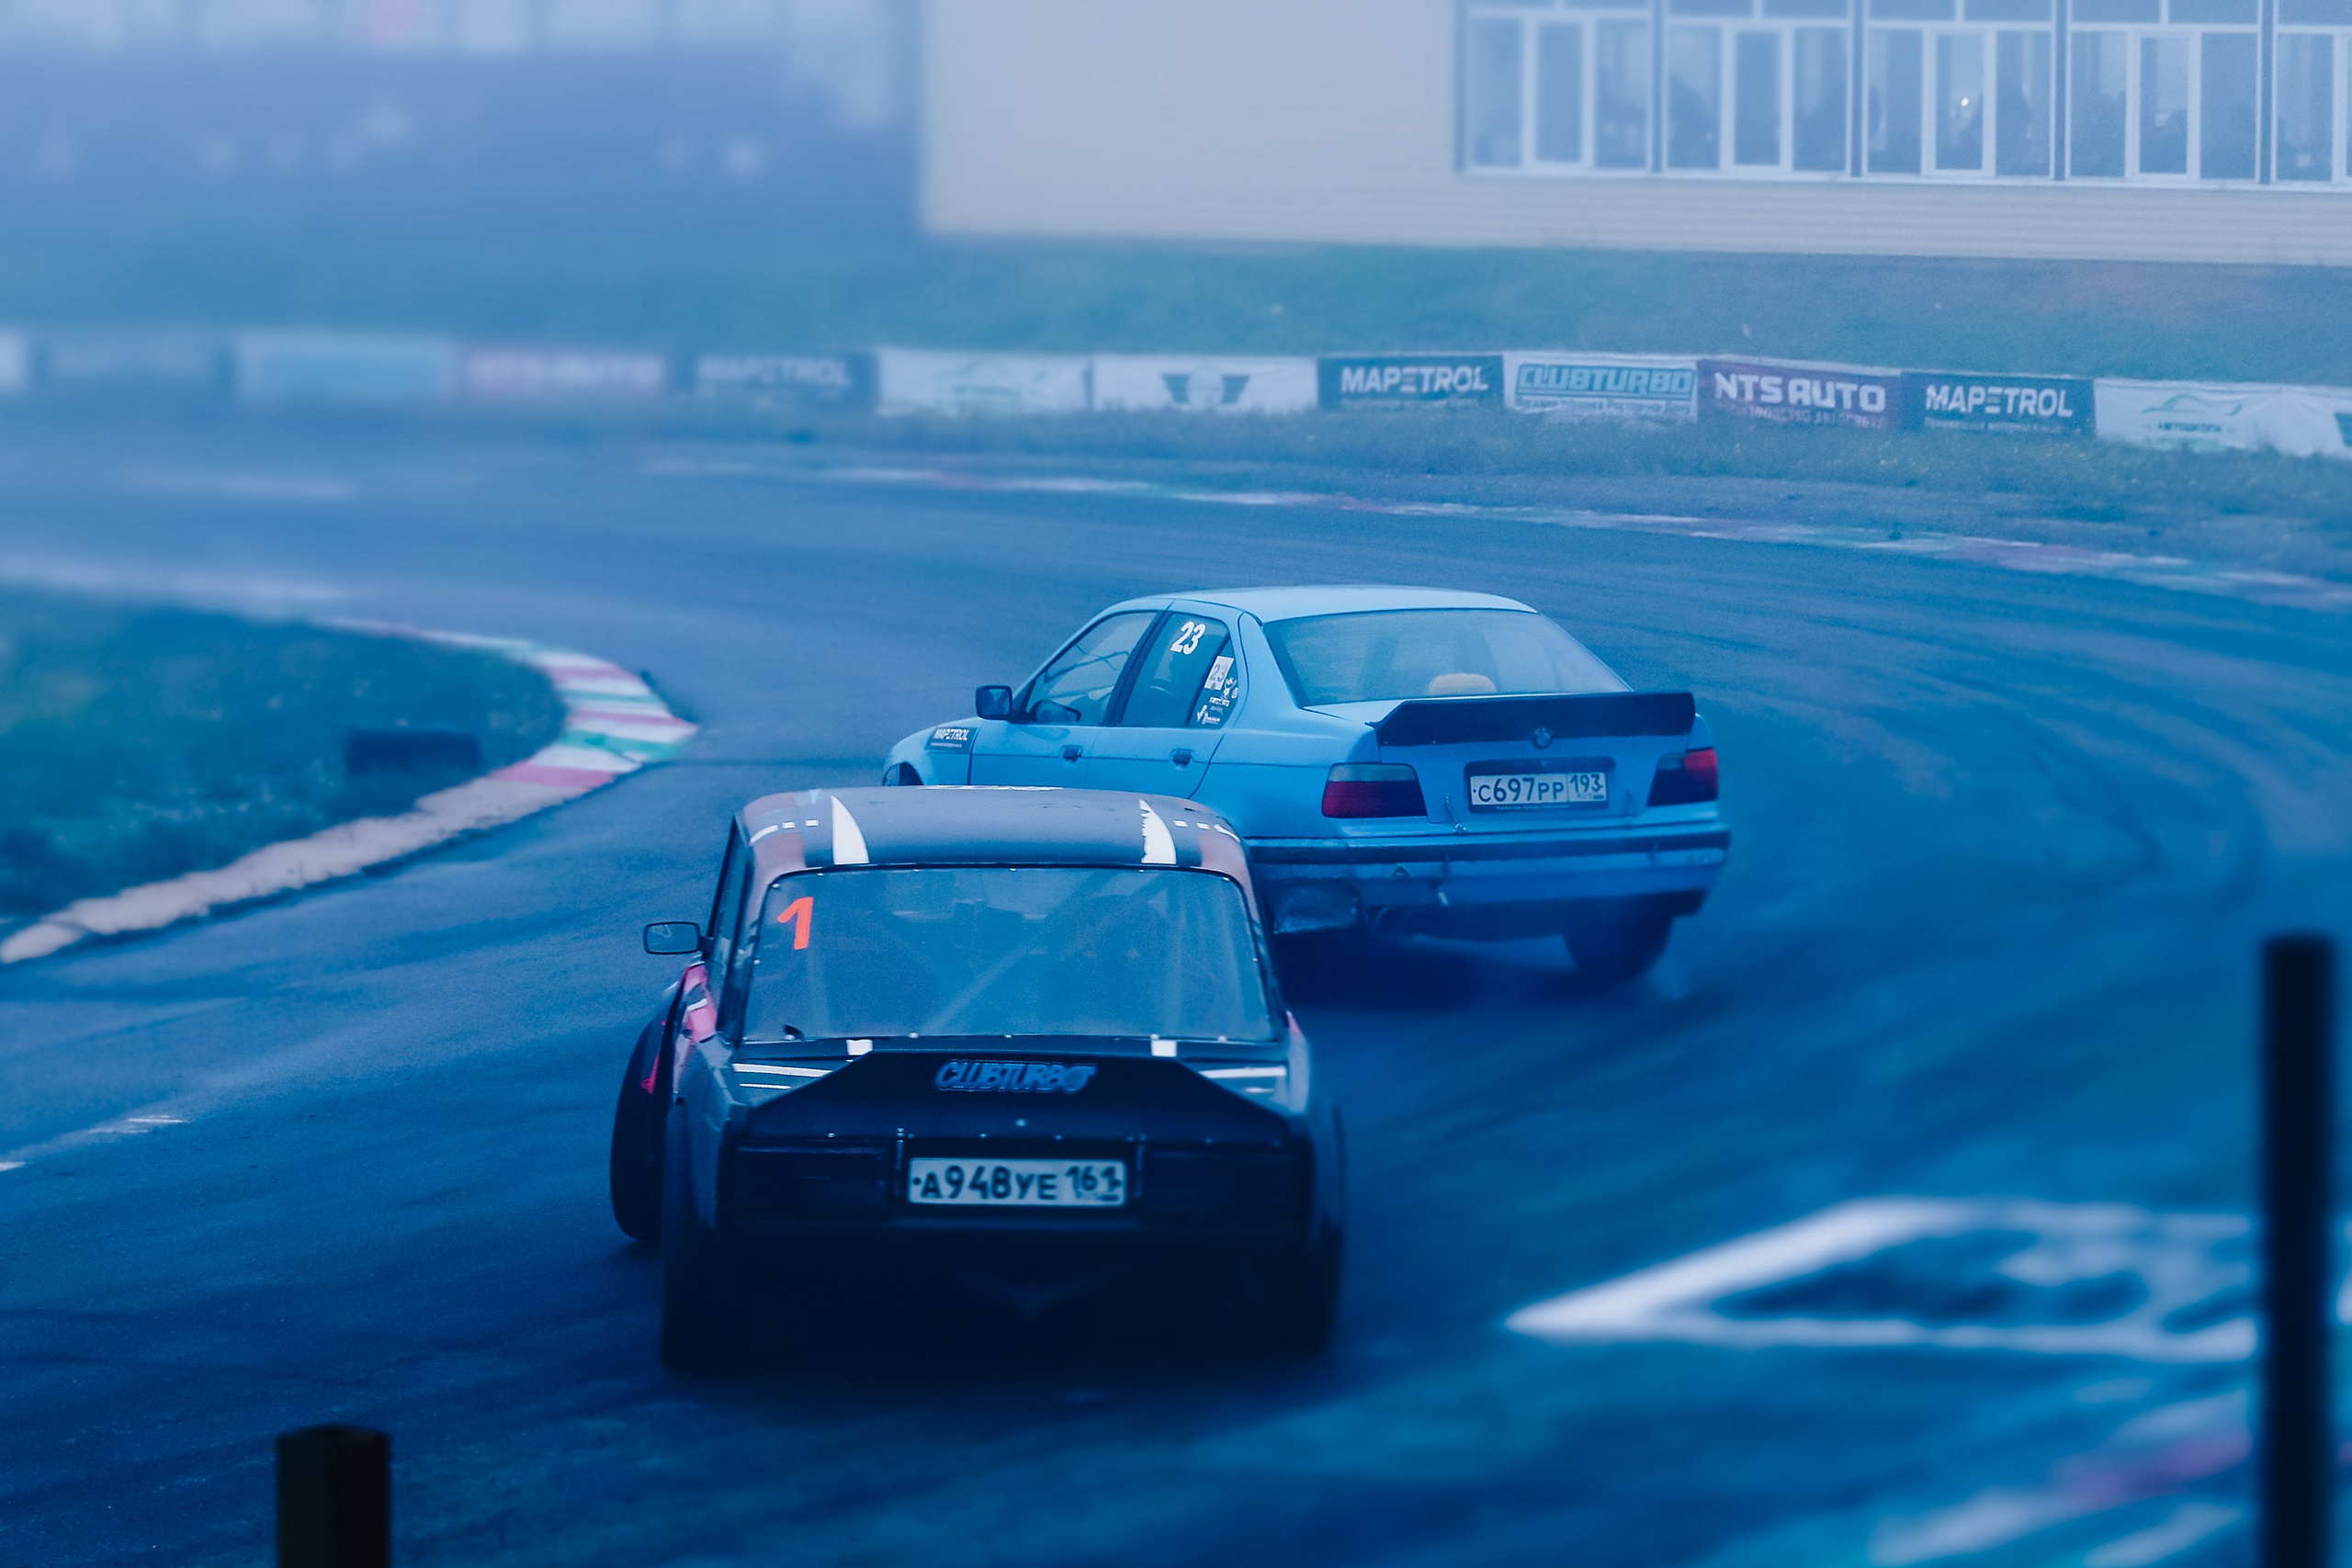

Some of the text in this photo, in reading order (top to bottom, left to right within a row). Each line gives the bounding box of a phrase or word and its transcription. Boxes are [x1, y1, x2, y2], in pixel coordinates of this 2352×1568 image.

[1340, 366, 1488, 393] MAPETROL
[1518, 364, 1694, 397] CLUBTURBO
[1713, 372, 1887, 413] NTS AUTO
[1924, 383, 2075, 418] MAPETROL
[1170, 620, 1206, 656] 23
[1569, 773, 1600, 794] 193
[777, 896, 814, 951] 1
[935, 1058, 1098, 1094] CLUBTURBO
[1064, 1165, 1117, 1193] 161
